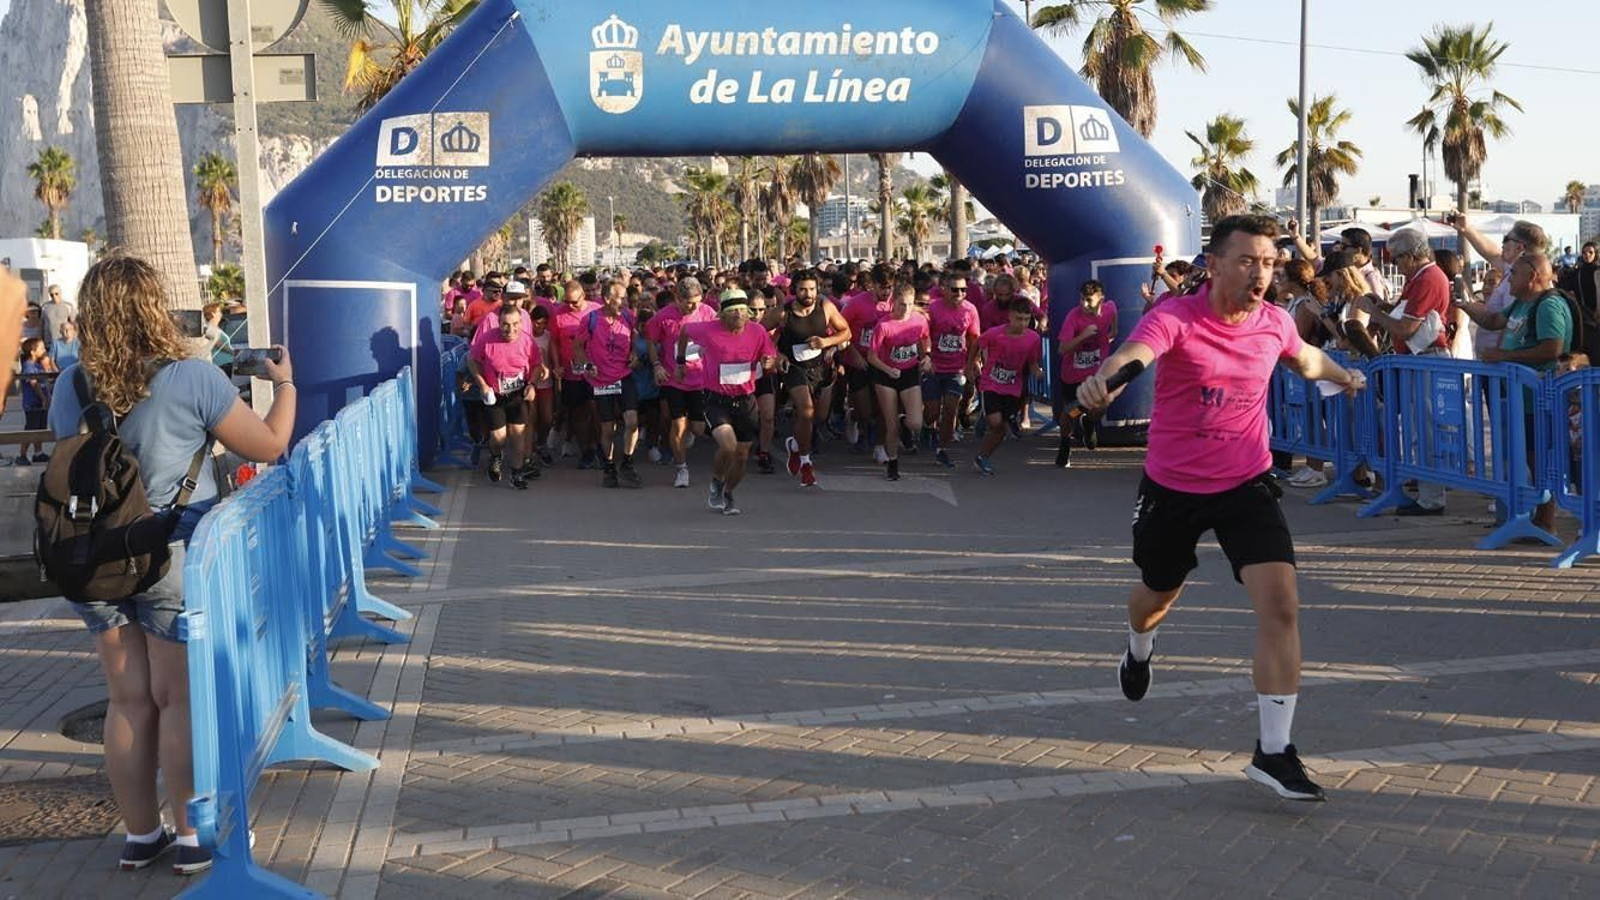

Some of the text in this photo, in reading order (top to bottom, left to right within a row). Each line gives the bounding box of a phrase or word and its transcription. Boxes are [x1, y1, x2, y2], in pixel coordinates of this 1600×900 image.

[656, 23, 939, 65] Ayuntamiento
[689, 68, 911, 104] de La Línea
[390, 127, 418, 155] D
[1036, 117, 1062, 146] D
[375, 167, 469, 179] DELEGACIÓN DE
[1025, 155, 1107, 168] DELEGACIÓN DE
[1025, 170, 1125, 189] DEPORTES
[376, 184, 488, 203] DEPORTES
